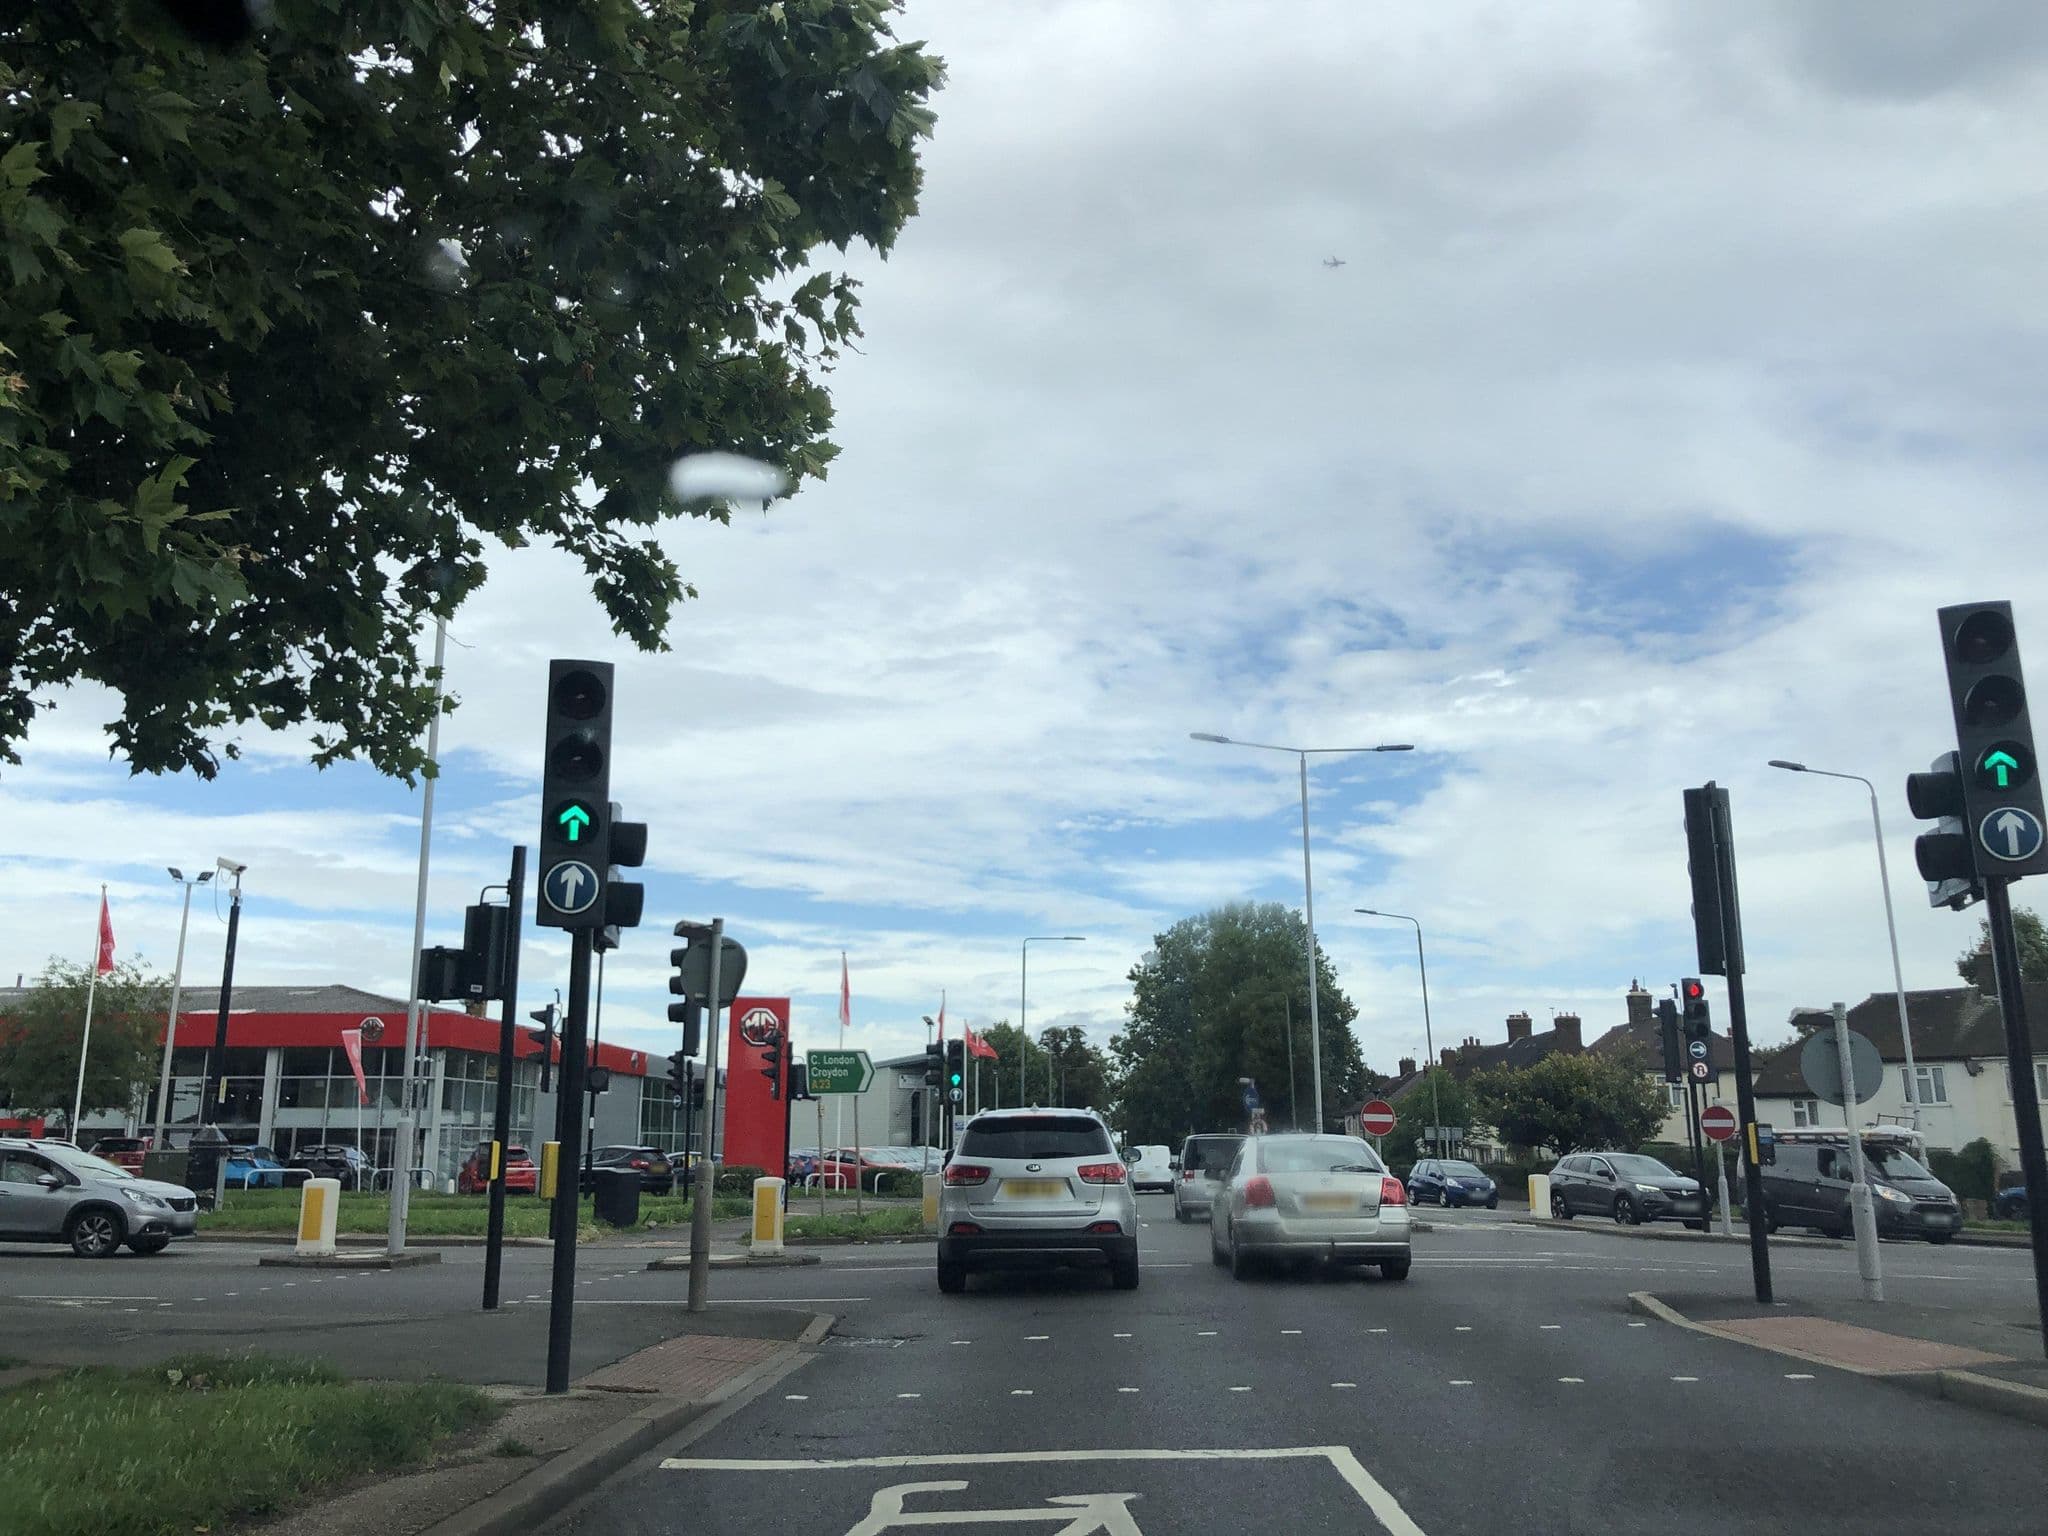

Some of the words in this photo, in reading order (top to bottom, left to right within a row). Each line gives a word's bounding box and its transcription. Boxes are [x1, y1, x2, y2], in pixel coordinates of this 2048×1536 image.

[811, 1055, 820, 1065] C.
[823, 1054, 856, 1065] London
[811, 1067, 849, 1078] Croydon
[811, 1079, 831, 1089] A23
